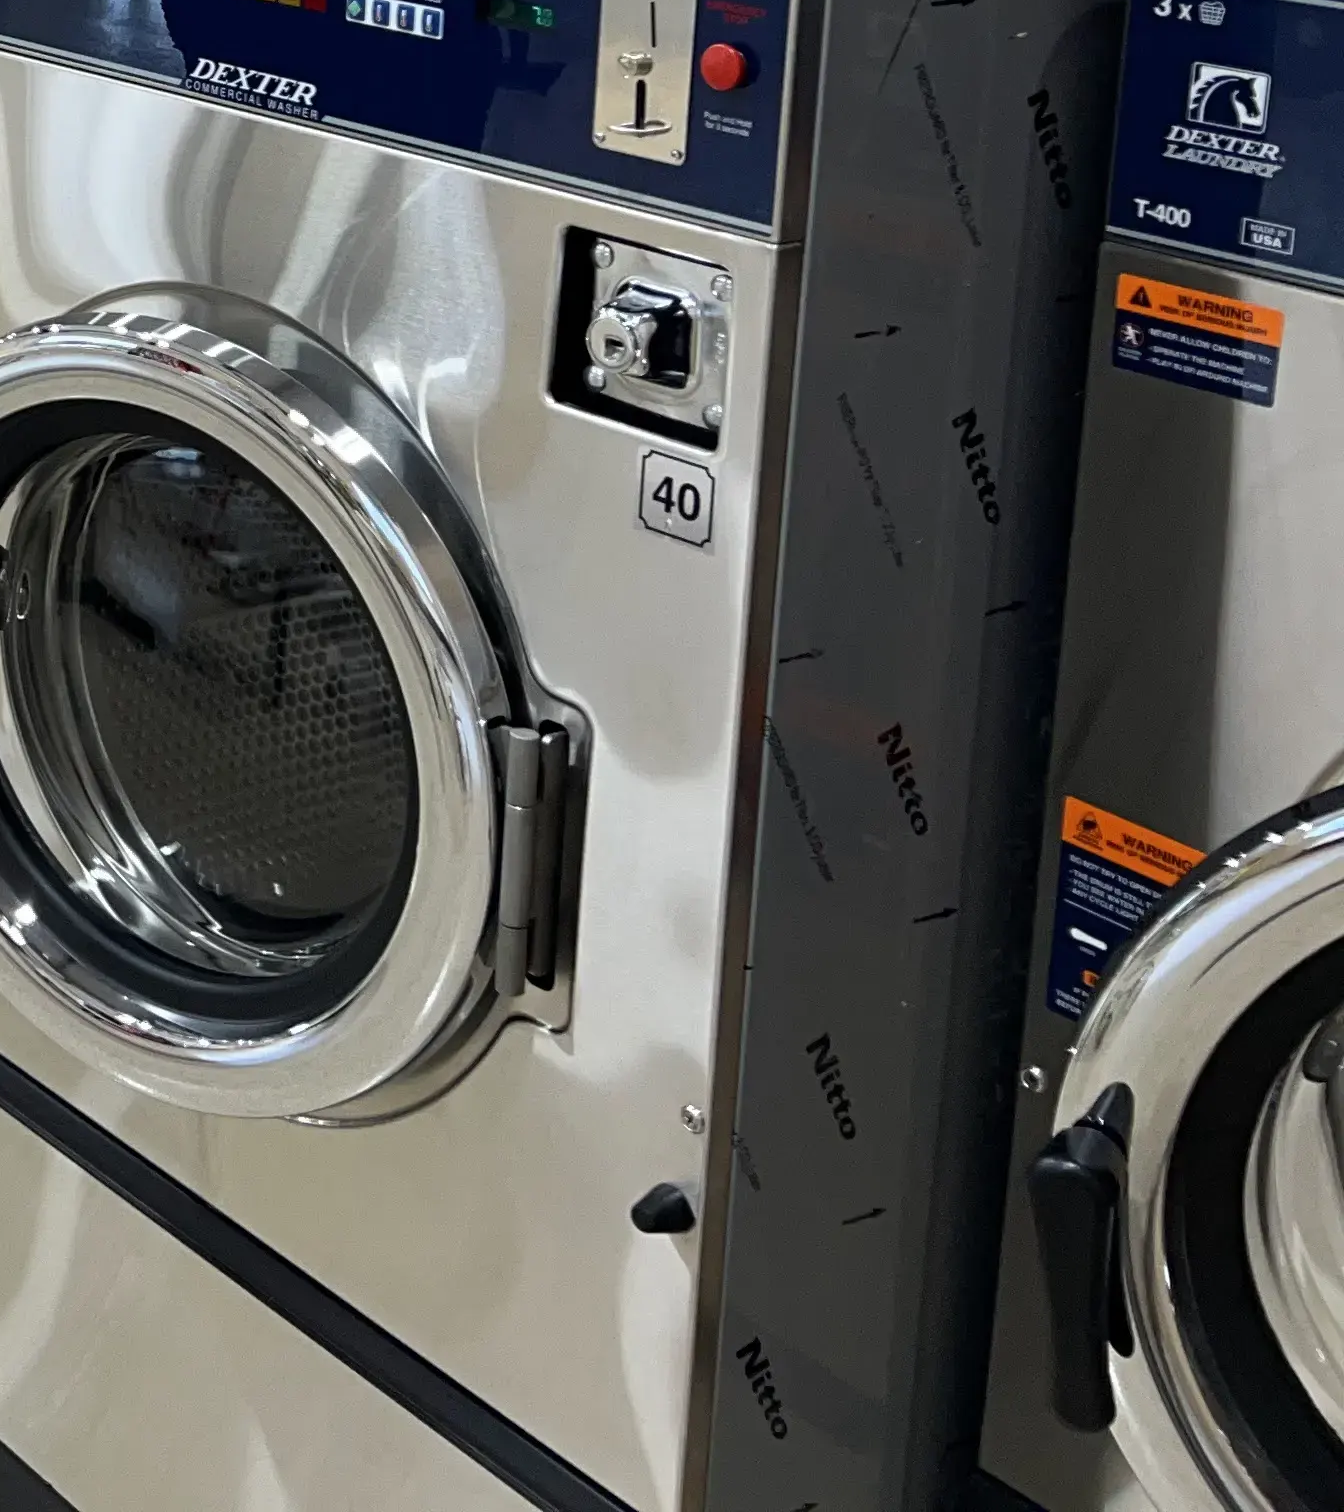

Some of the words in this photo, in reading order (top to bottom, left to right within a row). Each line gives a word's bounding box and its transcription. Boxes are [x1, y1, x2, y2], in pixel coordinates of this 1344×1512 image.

[1177, 3, 1193, 21] x
[185, 78, 263, 107] COMMERCIAL
[267, 98, 319, 120] WASHER
[190, 57, 318, 105] DEXTER
[1027, 88, 1073, 209] Nitto
[1162, 144, 1283, 179] LAUNDRY
[1164, 125, 1281, 162] DEXTER
[1134, 197, 1192, 229] T-400
[1252, 232, 1282, 249] USA
[1178, 295, 1254, 323] WARNING
[952, 407, 1001, 526] Nitto
[653, 475, 701, 522] 40
[877, 721, 930, 838] Nitto
[1122, 832, 1194, 873] WARNING
[806, 1032, 857, 1141] Nitto
[736, 1336, 789, 1441] Nitto
